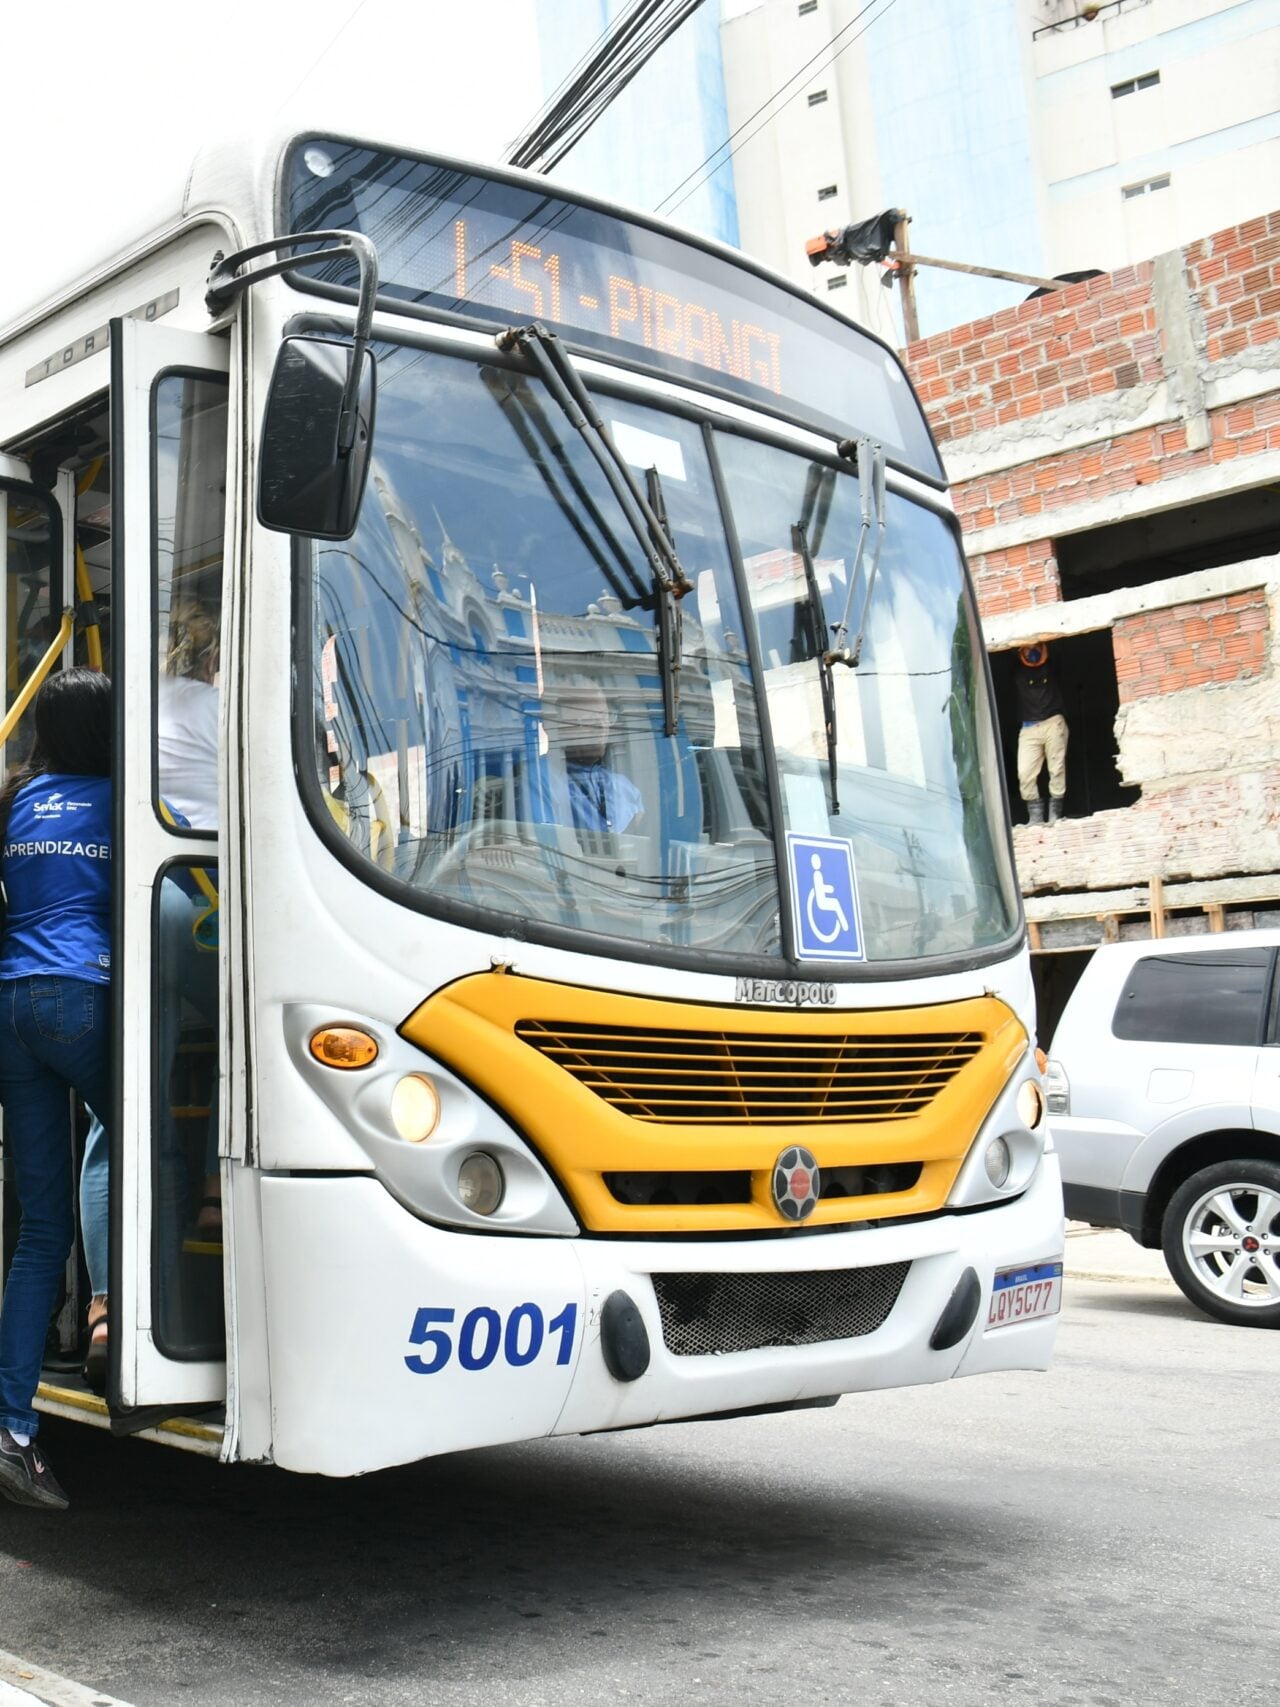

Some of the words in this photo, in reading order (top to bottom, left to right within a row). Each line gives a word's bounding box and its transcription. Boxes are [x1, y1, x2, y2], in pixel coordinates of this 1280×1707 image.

[44, 302, 157, 374] TORO
[609, 275, 781, 395] PIRANGI
[3, 841, 112, 860] APRENDIZAGE
[735, 977, 837, 1006] Marcopolo
[988, 1281, 1053, 1323] LQY5C77
[404, 1302, 577, 1374] 5001
